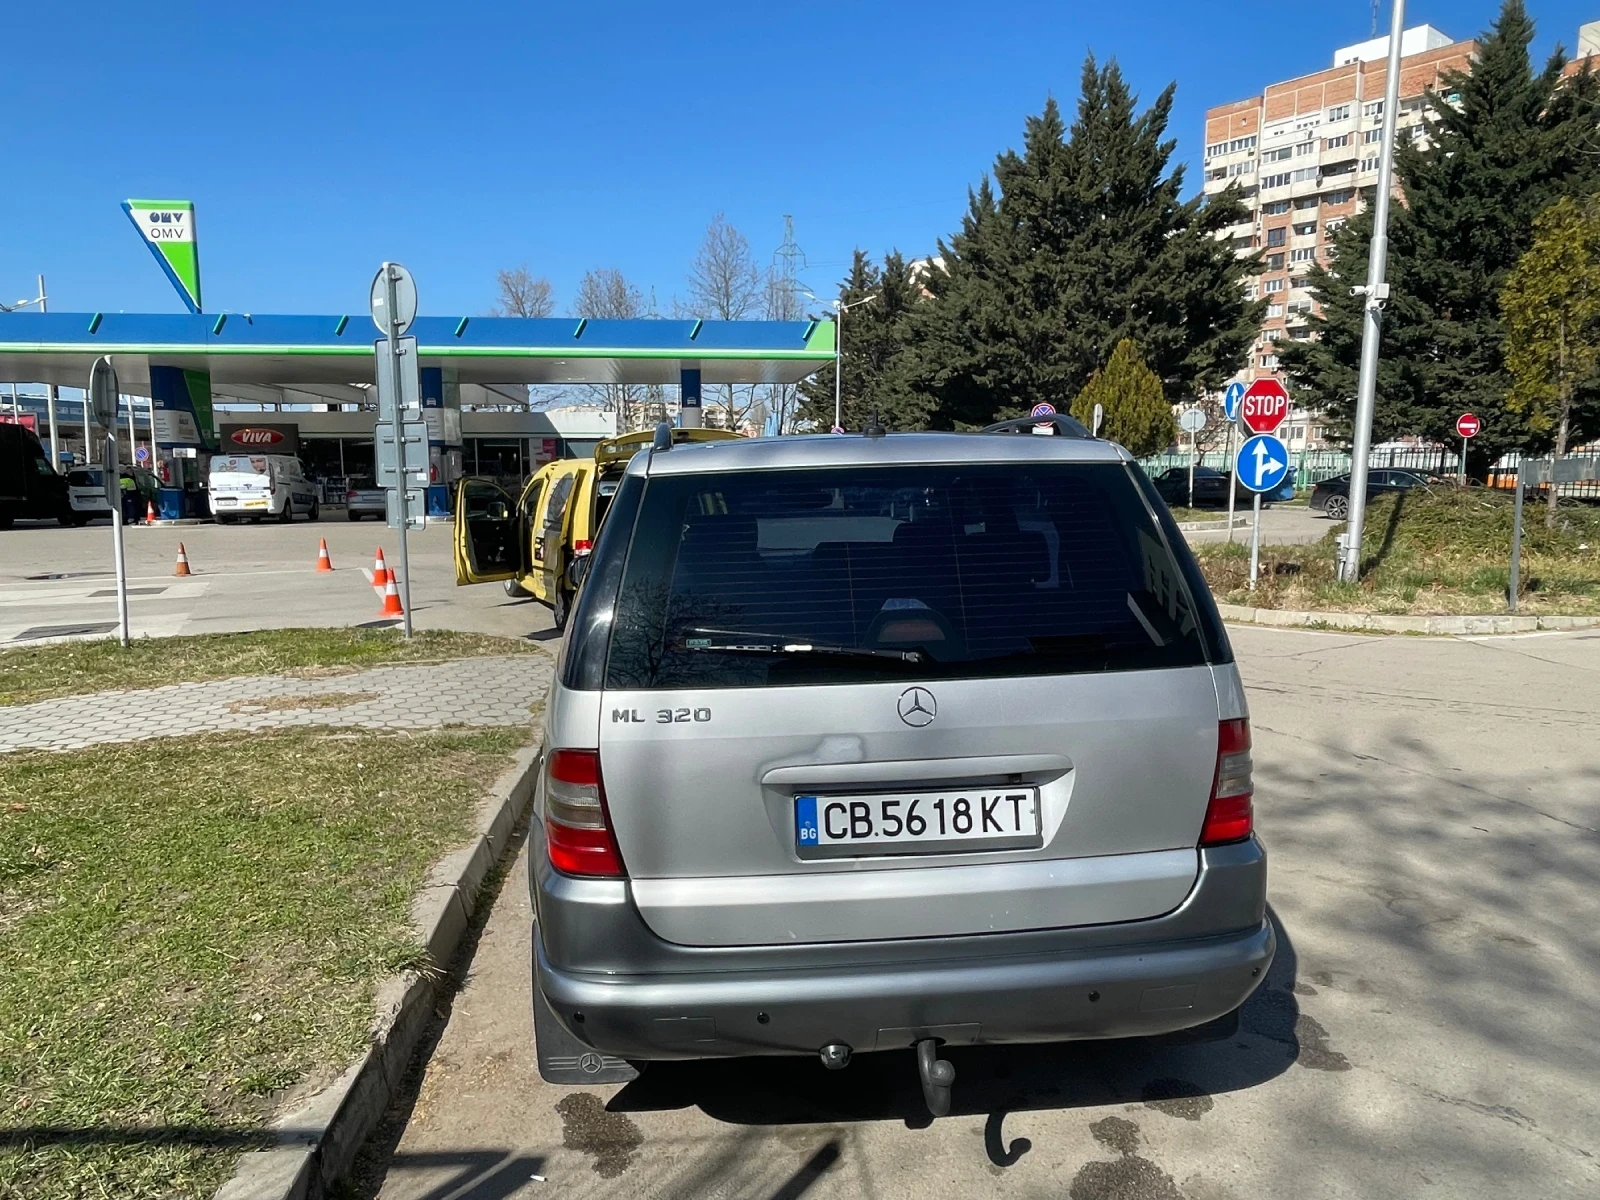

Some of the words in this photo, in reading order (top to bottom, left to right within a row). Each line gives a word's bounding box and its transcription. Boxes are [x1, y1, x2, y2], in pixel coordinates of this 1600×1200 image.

[151, 228, 184, 239] OMV
[1245, 395, 1285, 416] STOP
[242, 432, 272, 443] VIVA
[612, 708, 646, 723] ML
[655, 707, 712, 724] 320
[801, 827, 817, 841] BG
